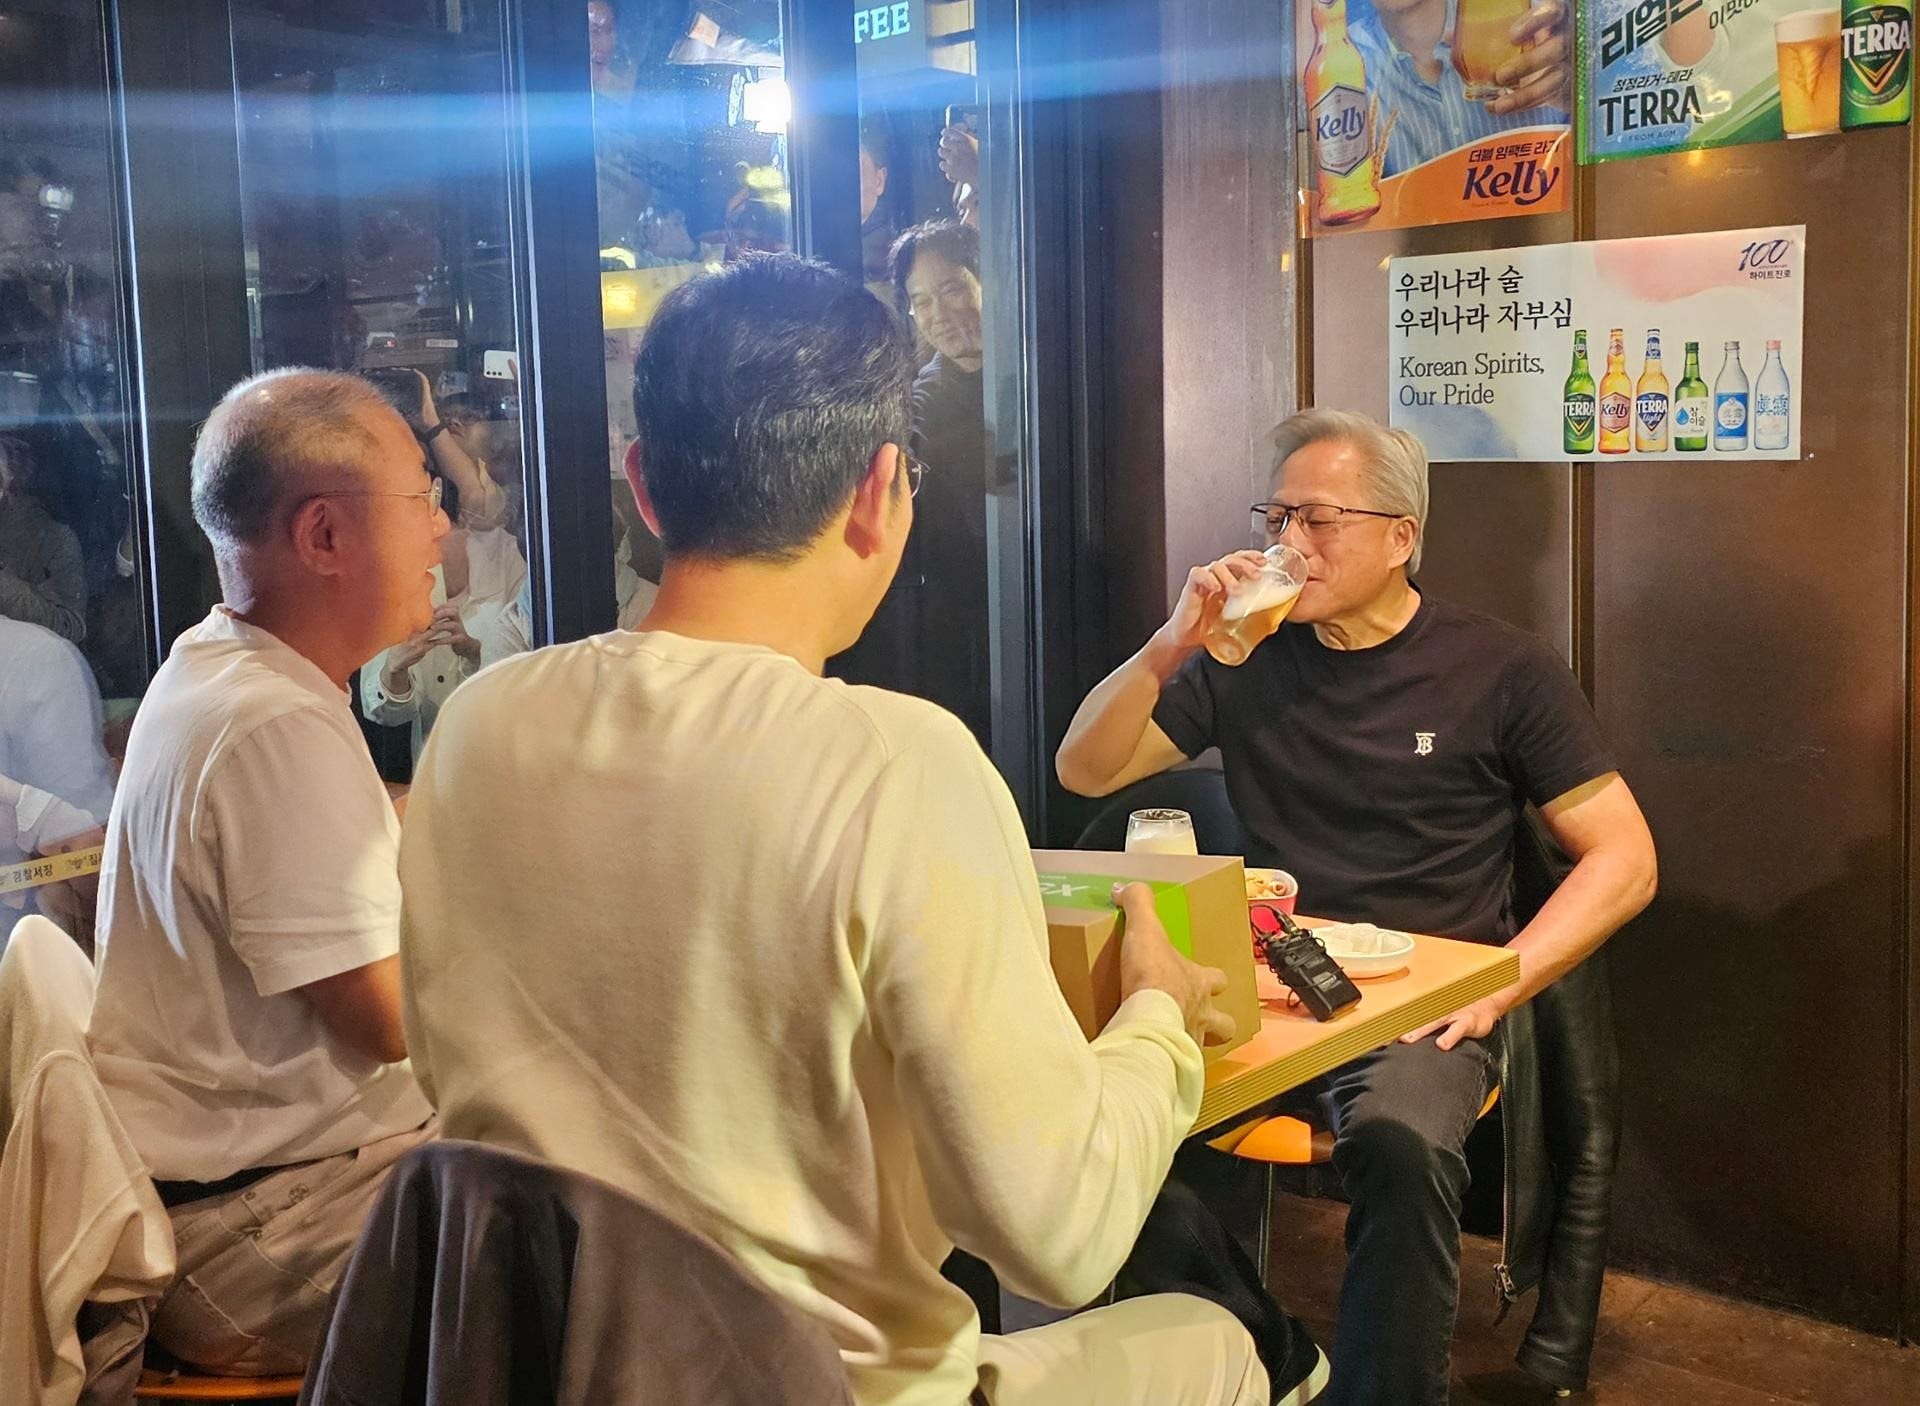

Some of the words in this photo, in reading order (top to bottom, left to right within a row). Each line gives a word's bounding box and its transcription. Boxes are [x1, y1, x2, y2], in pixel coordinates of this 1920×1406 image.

[854, 1, 910, 43] FEE
[1842, 20, 1911, 59] TERRA
[1316, 106, 1366, 141] Kelly
[1599, 85, 1704, 137] TERRA
[1469, 148, 1494, 162] 더블
[1496, 143, 1533, 160] 임팩트
[1463, 159, 1560, 206] Kelly
[1738, 239, 1790, 271] 100
[1395, 266, 1490, 302] 우리나라
[1497, 264, 1524, 294] 술
[1749, 269, 1792, 280] 하이트진로
[1395, 303, 1490, 337] 우리나라
[1497, 297, 1573, 331] 자부심
[1400, 356, 1467, 378] Korean
[1475, 352, 1545, 379] Spirits,
[1400, 385, 1437, 407] Our
[1443, 382, 1495, 405] Pride
[1563, 401, 1595, 417] TERRA
[1637, 400, 1668, 414] TERRA
[1600, 404, 1629, 419] Kelly
